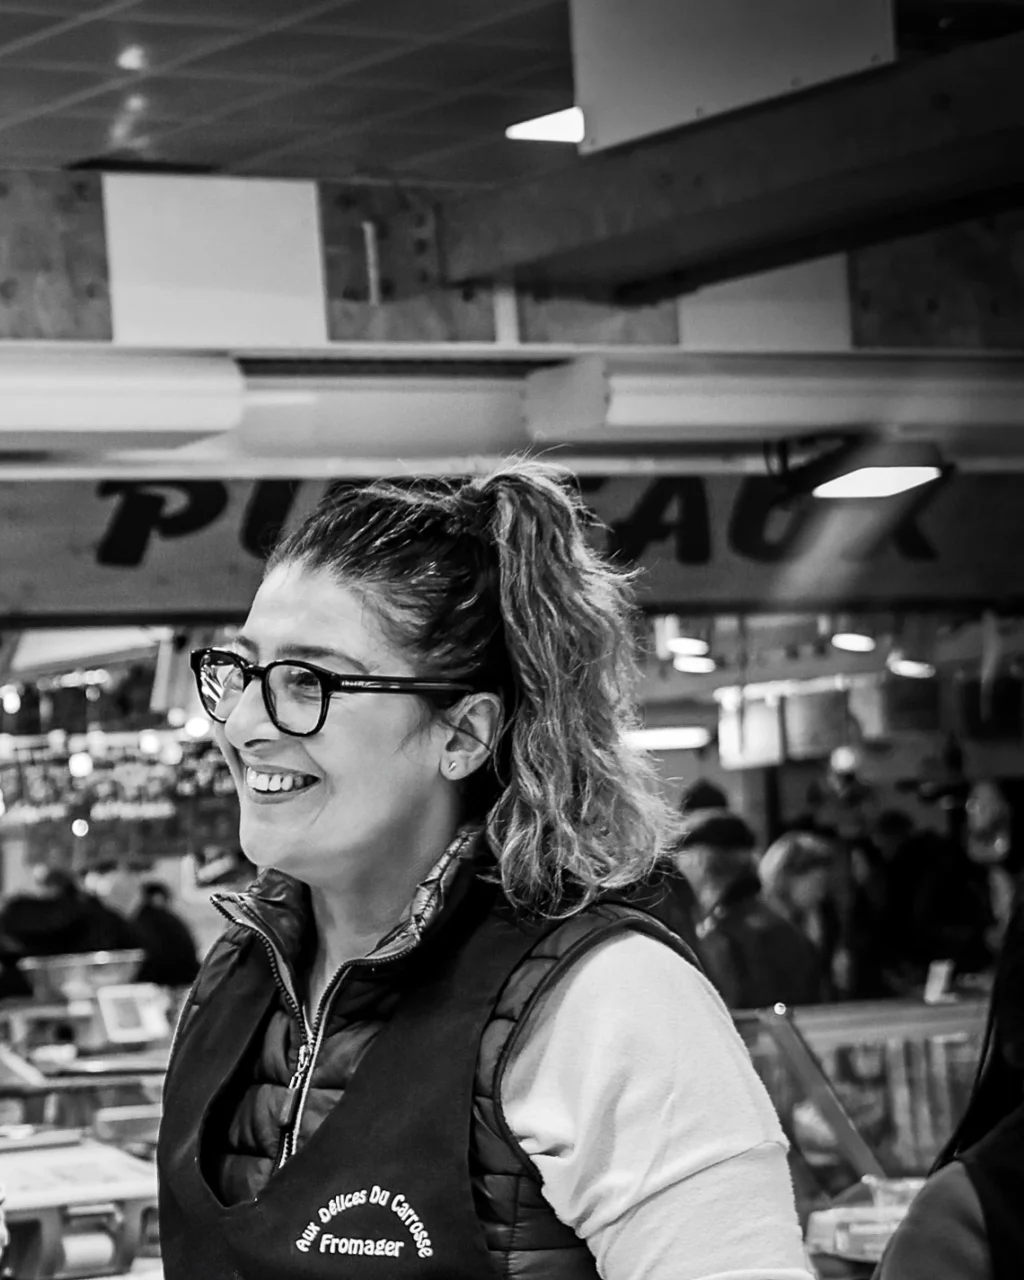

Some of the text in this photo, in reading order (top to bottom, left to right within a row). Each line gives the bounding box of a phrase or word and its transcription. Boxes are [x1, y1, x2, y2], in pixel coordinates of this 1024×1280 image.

[295, 1222, 321, 1252] Aux
[391, 1194, 434, 1258] Carrosse
[319, 1234, 405, 1258] Fromager
